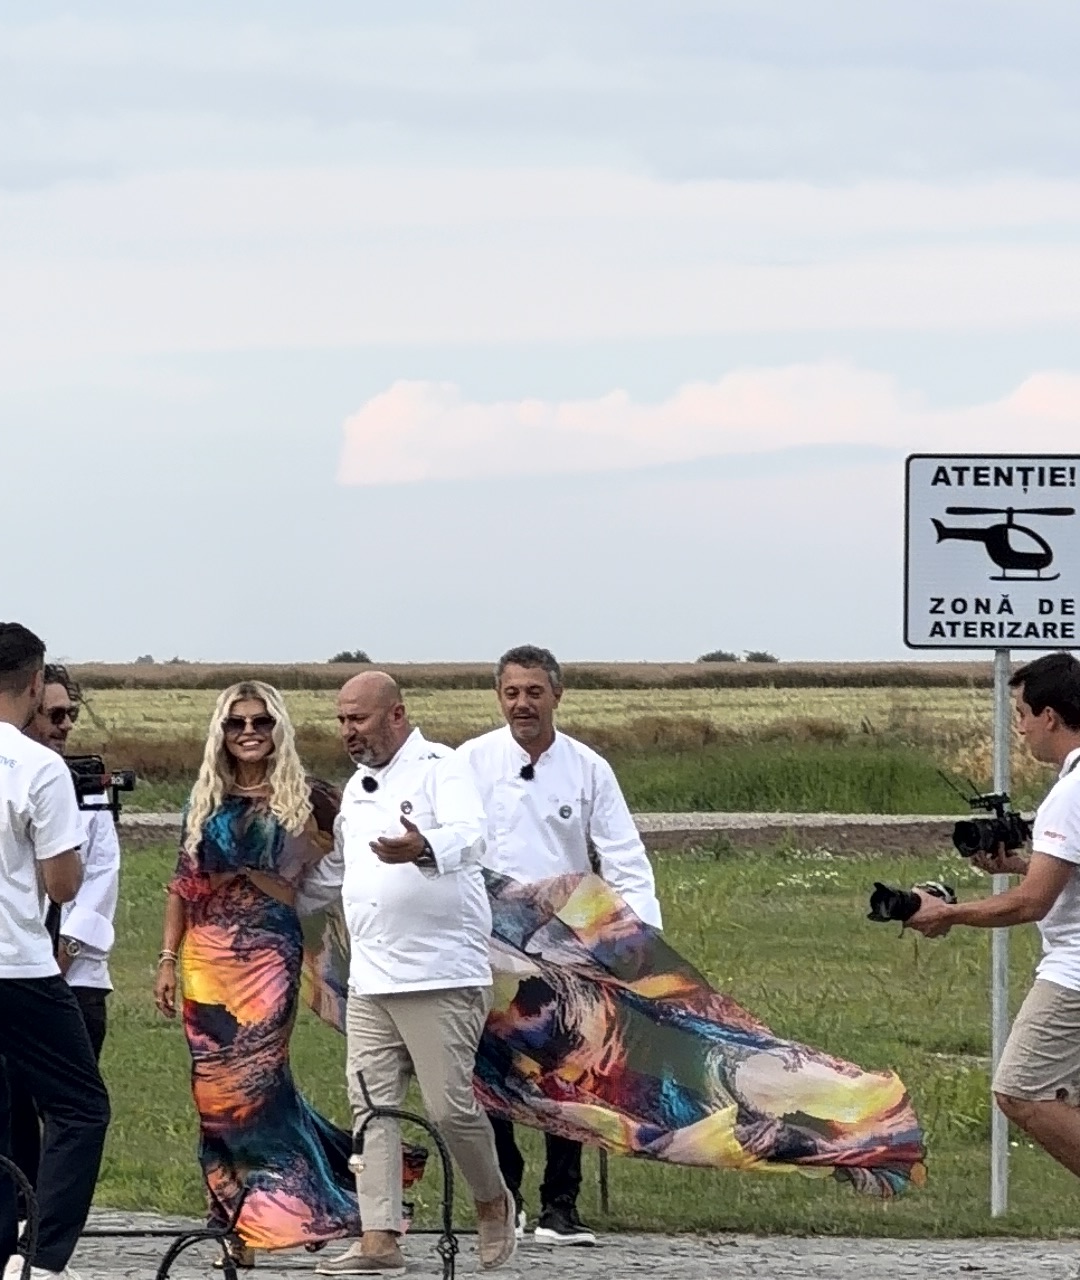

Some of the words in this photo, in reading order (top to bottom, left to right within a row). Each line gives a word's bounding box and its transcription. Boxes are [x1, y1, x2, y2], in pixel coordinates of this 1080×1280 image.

[930, 465, 1076, 494] ATENȚIE!
[928, 593, 1014, 615] ZONĂ
[1038, 598, 1075, 616] DE
[928, 620, 1075, 639] ATERIZARE
